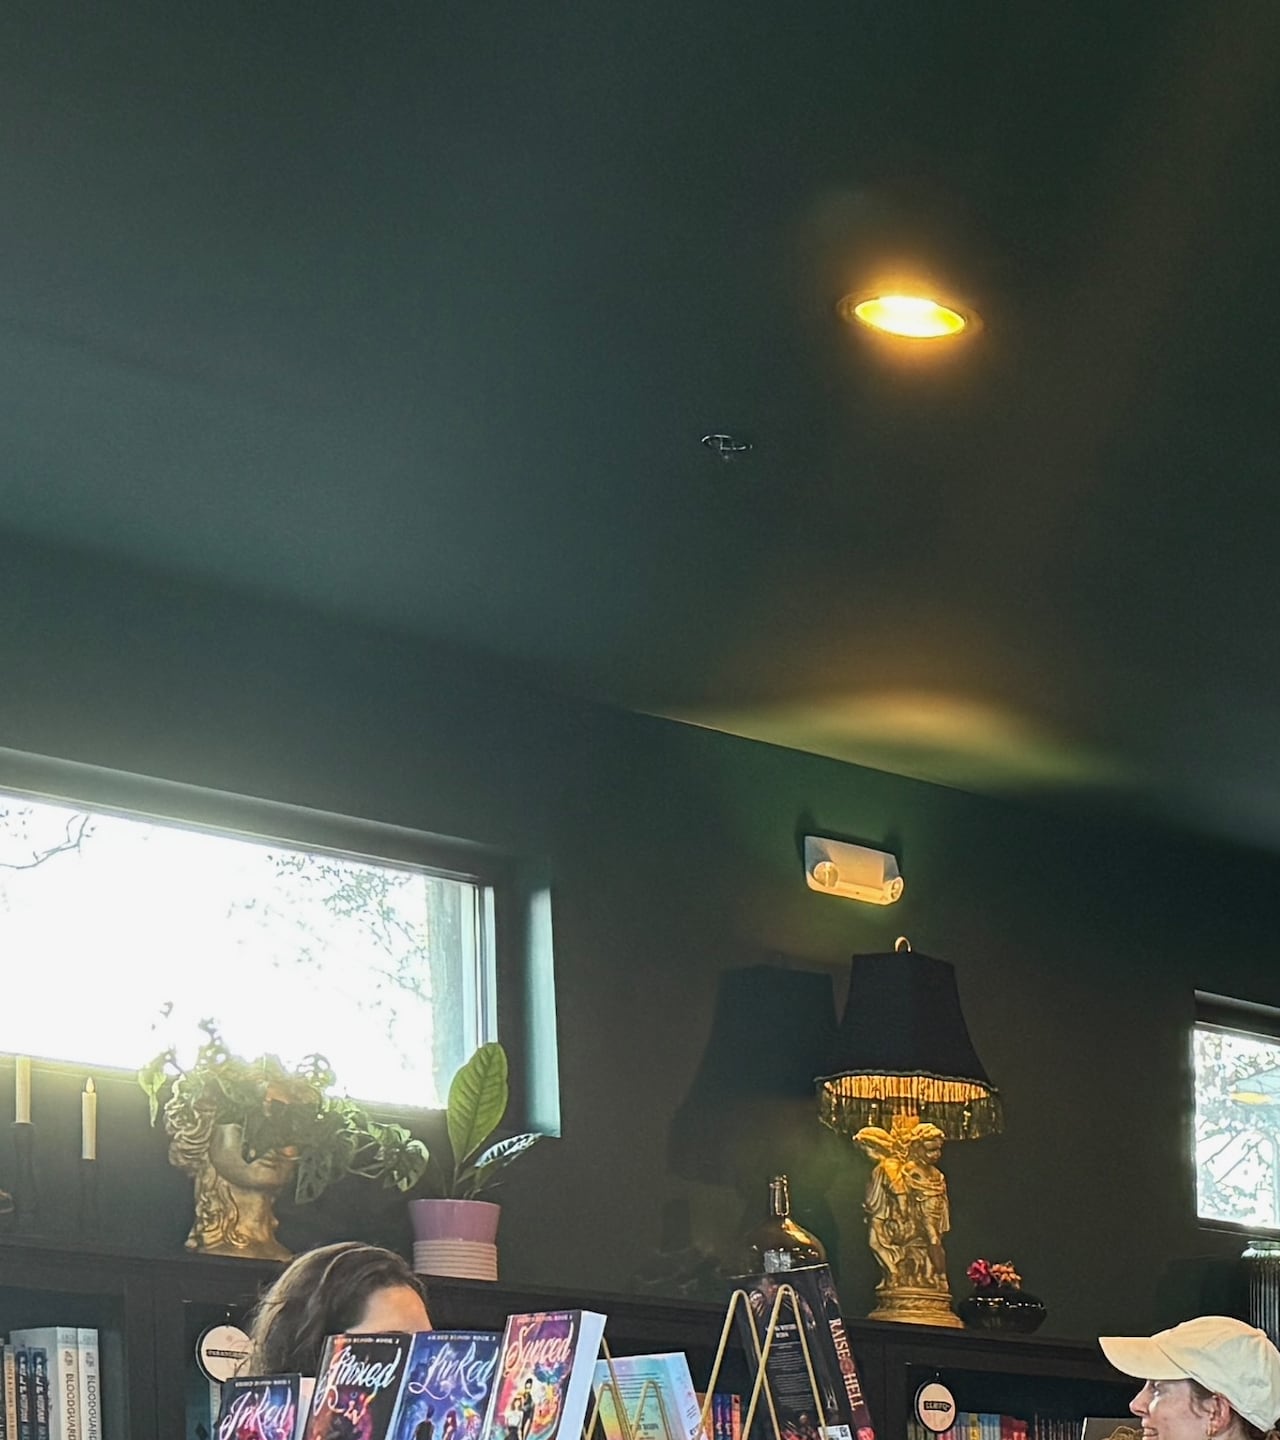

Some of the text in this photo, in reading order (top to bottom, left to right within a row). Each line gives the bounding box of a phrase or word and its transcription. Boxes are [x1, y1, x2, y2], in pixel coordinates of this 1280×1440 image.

[408, 1341, 499, 1400] Linked
[503, 1322, 574, 1378] Synced
[828, 1316, 864, 1411] RAISE HELL
